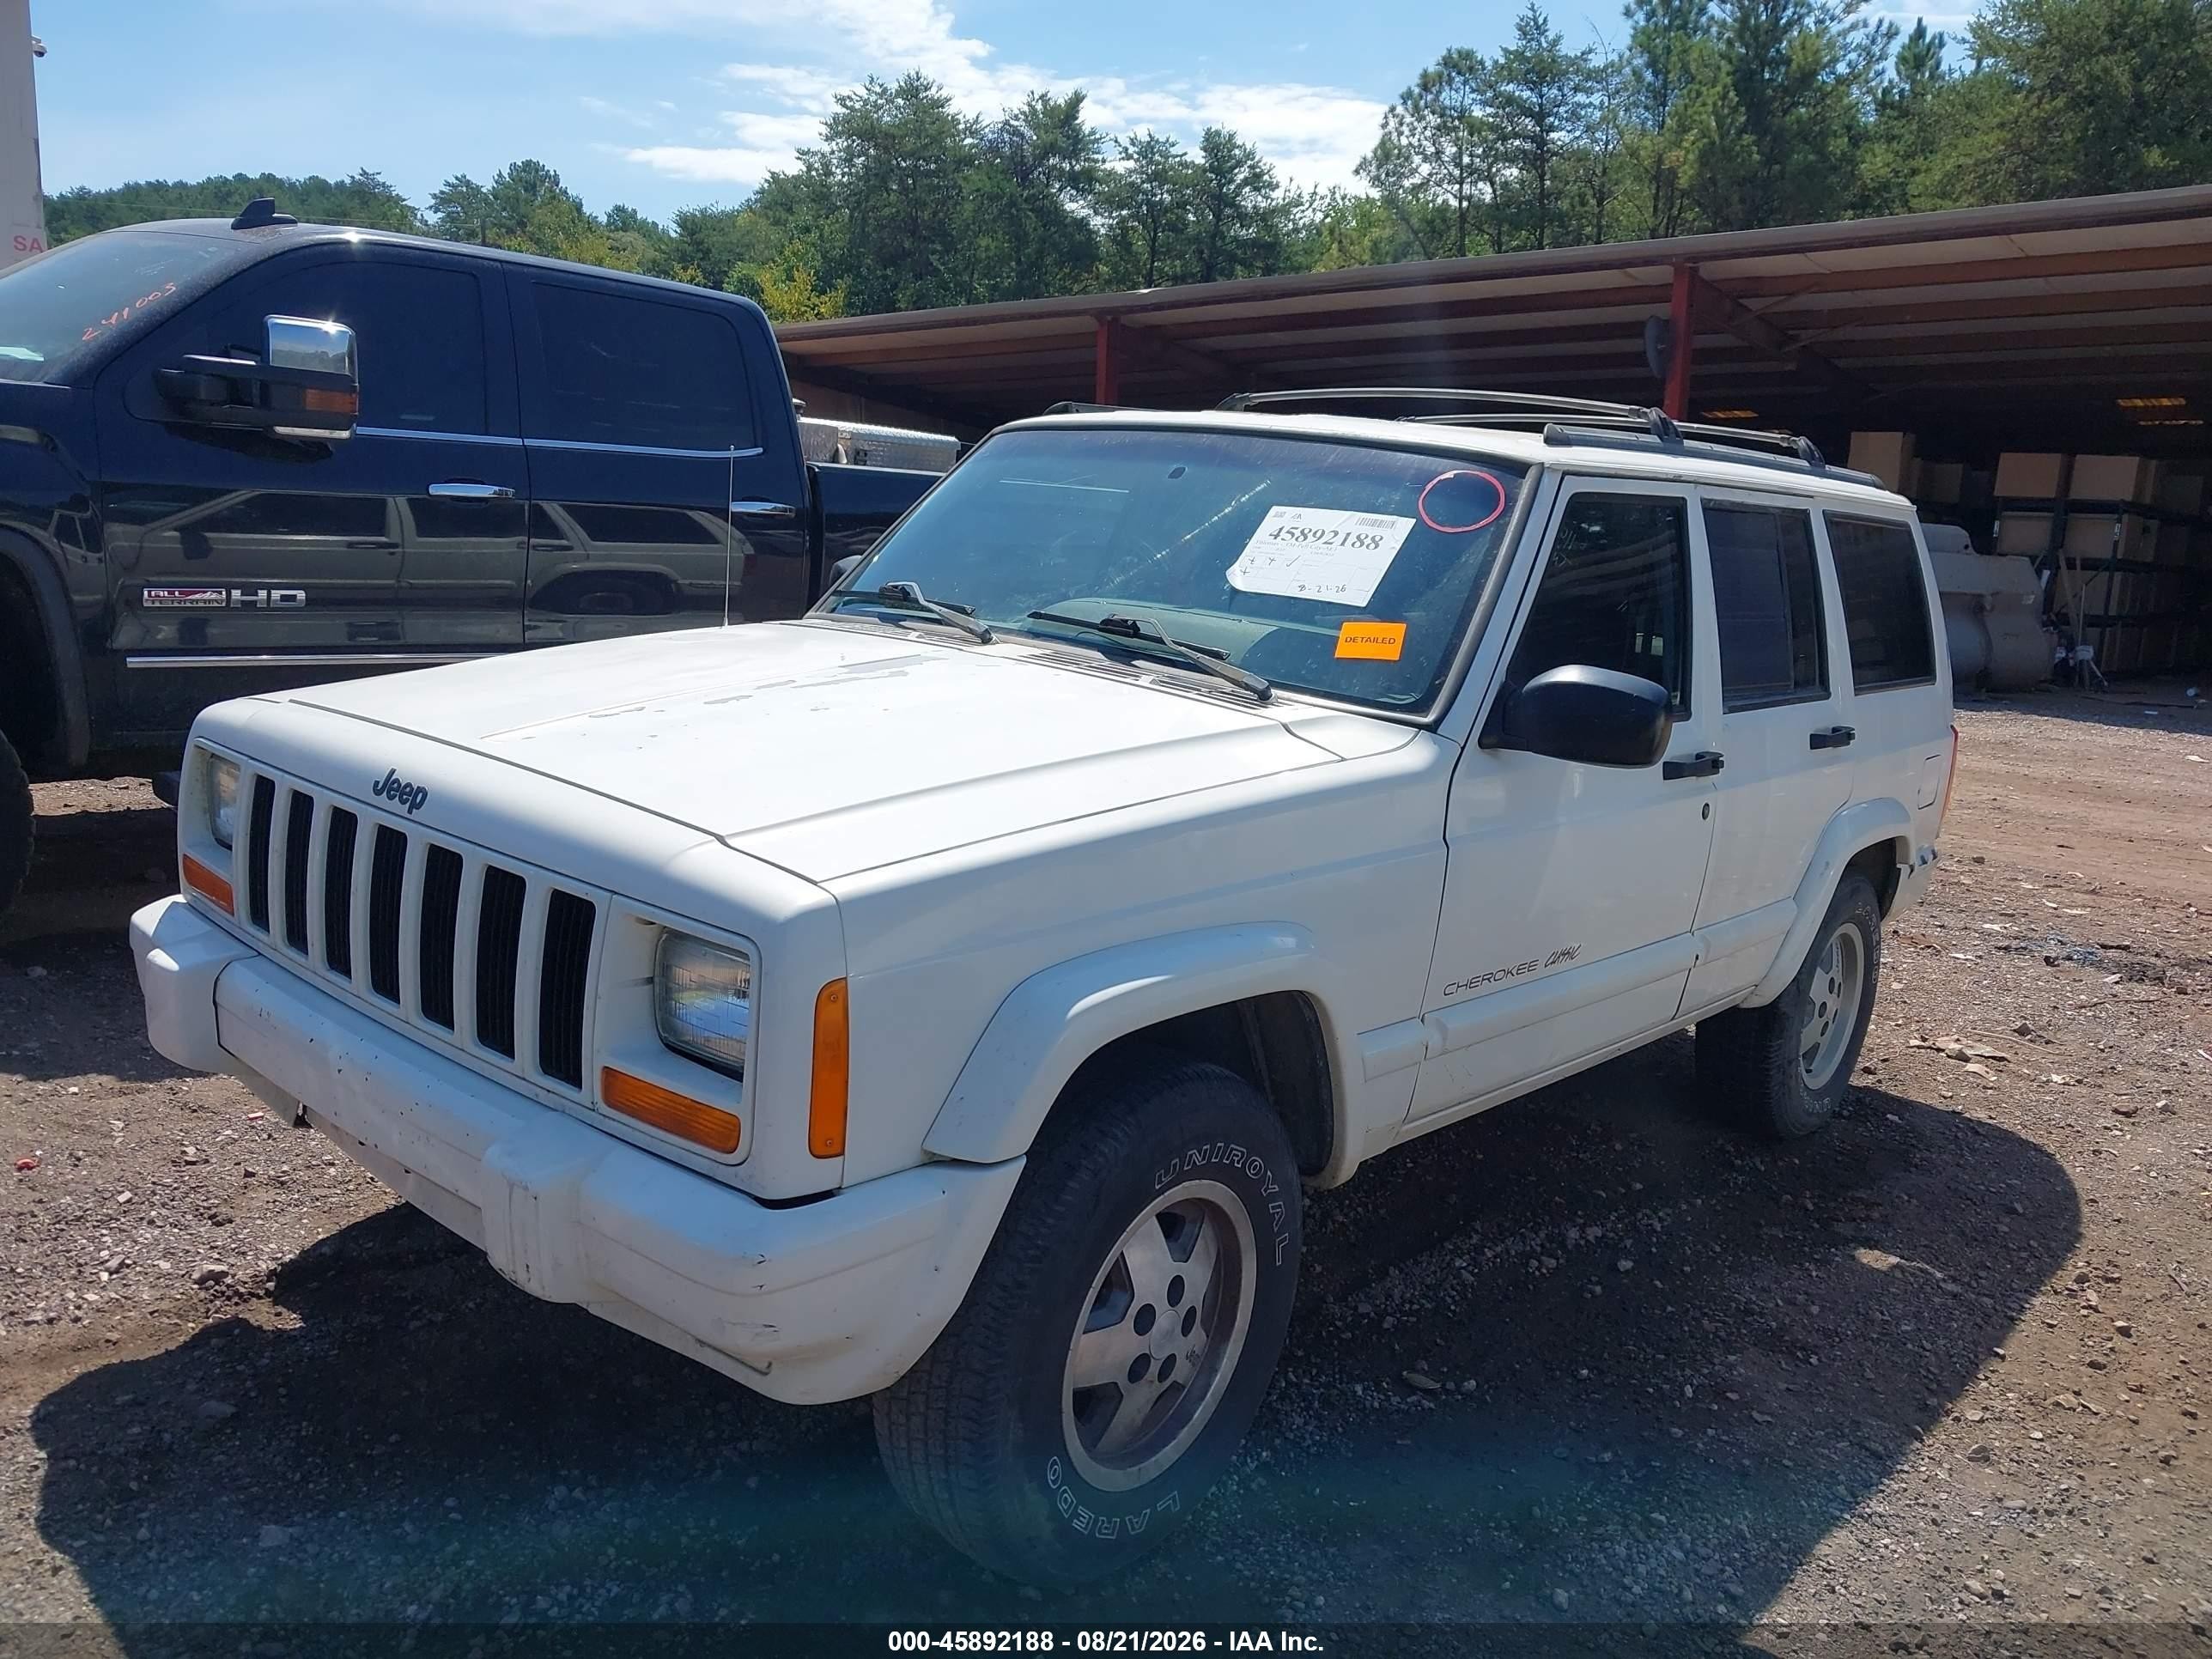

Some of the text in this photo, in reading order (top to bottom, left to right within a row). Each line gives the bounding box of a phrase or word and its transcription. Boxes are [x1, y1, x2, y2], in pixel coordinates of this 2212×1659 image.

[1268, 526, 1383, 550] 45892188
[231, 589, 306, 607] HD
[1345, 636, 1396, 645] DETAILED
[372, 768, 428, 815] Jeep
[1443, 959, 1540, 996] CHEROKEE
[1155, 1142, 1289, 1266] UNIROYAL
[1047, 1455, 1182, 1540] LAREDO
